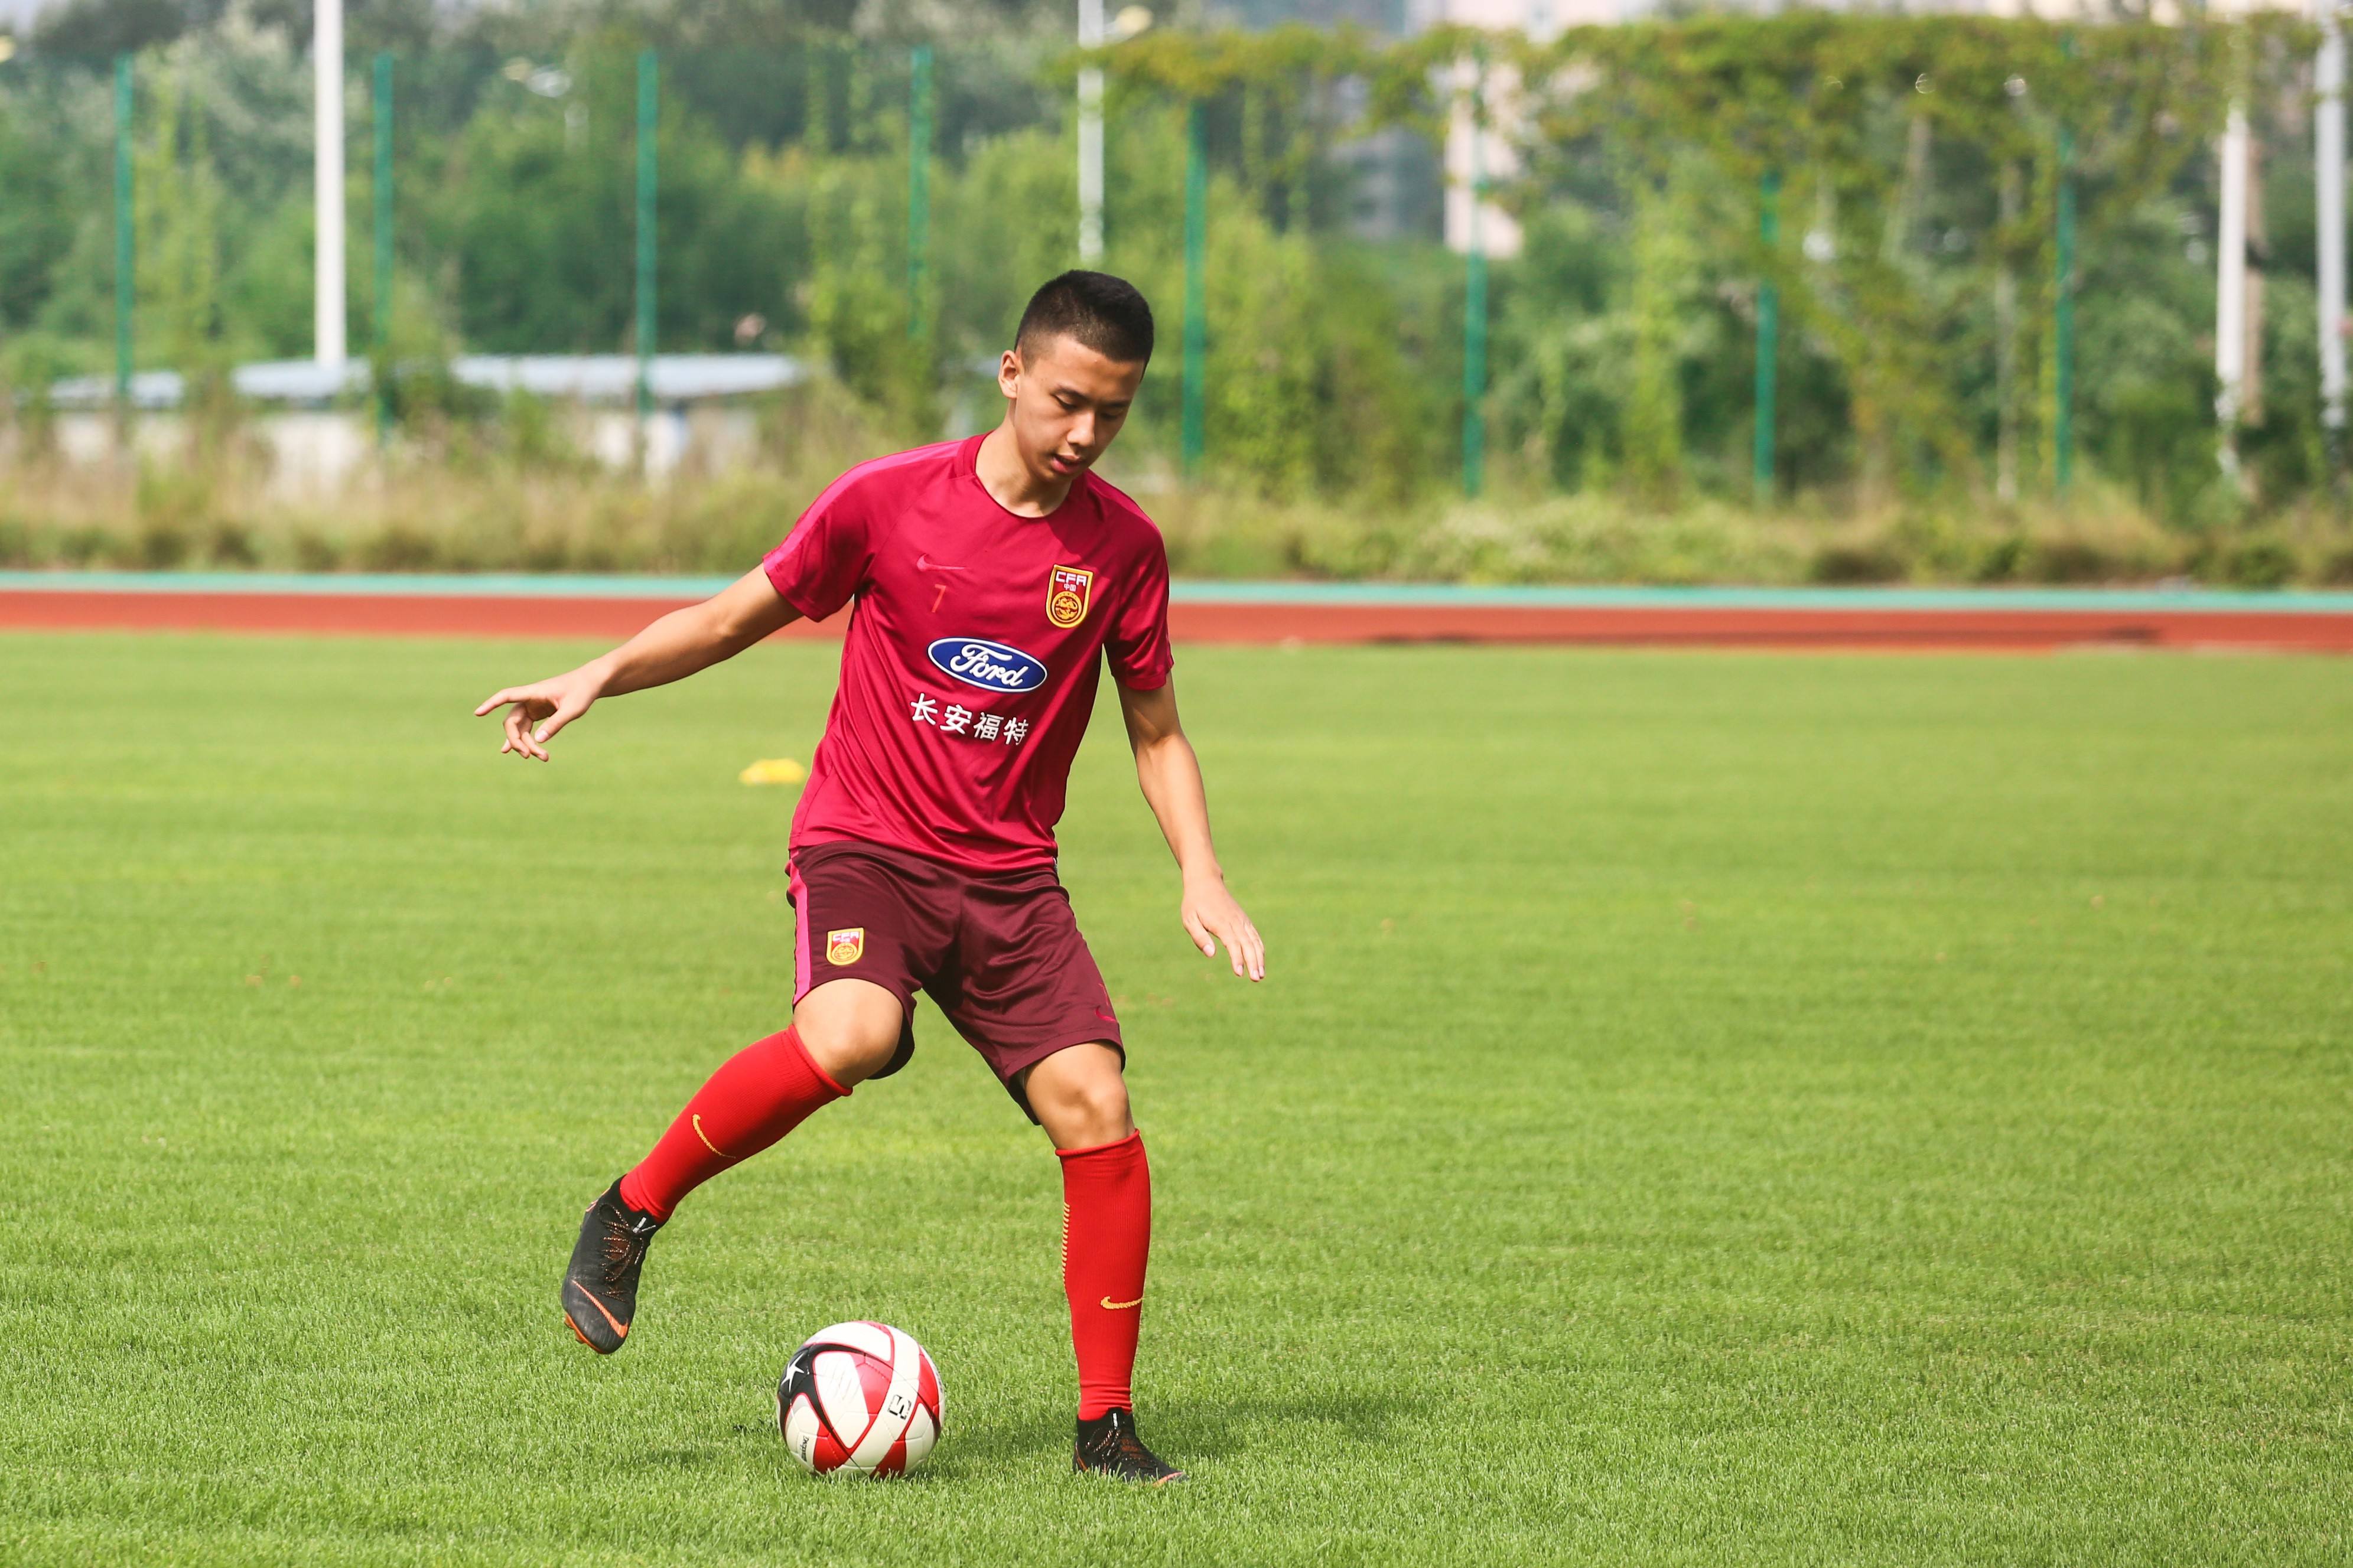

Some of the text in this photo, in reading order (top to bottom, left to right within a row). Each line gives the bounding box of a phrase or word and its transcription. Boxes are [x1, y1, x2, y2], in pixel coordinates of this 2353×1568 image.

[1055, 571, 1087, 586] CFA
[932, 583, 946, 613] 7
[950, 644, 1029, 687] Ford
[910, 693, 1029, 746] 长安福特
